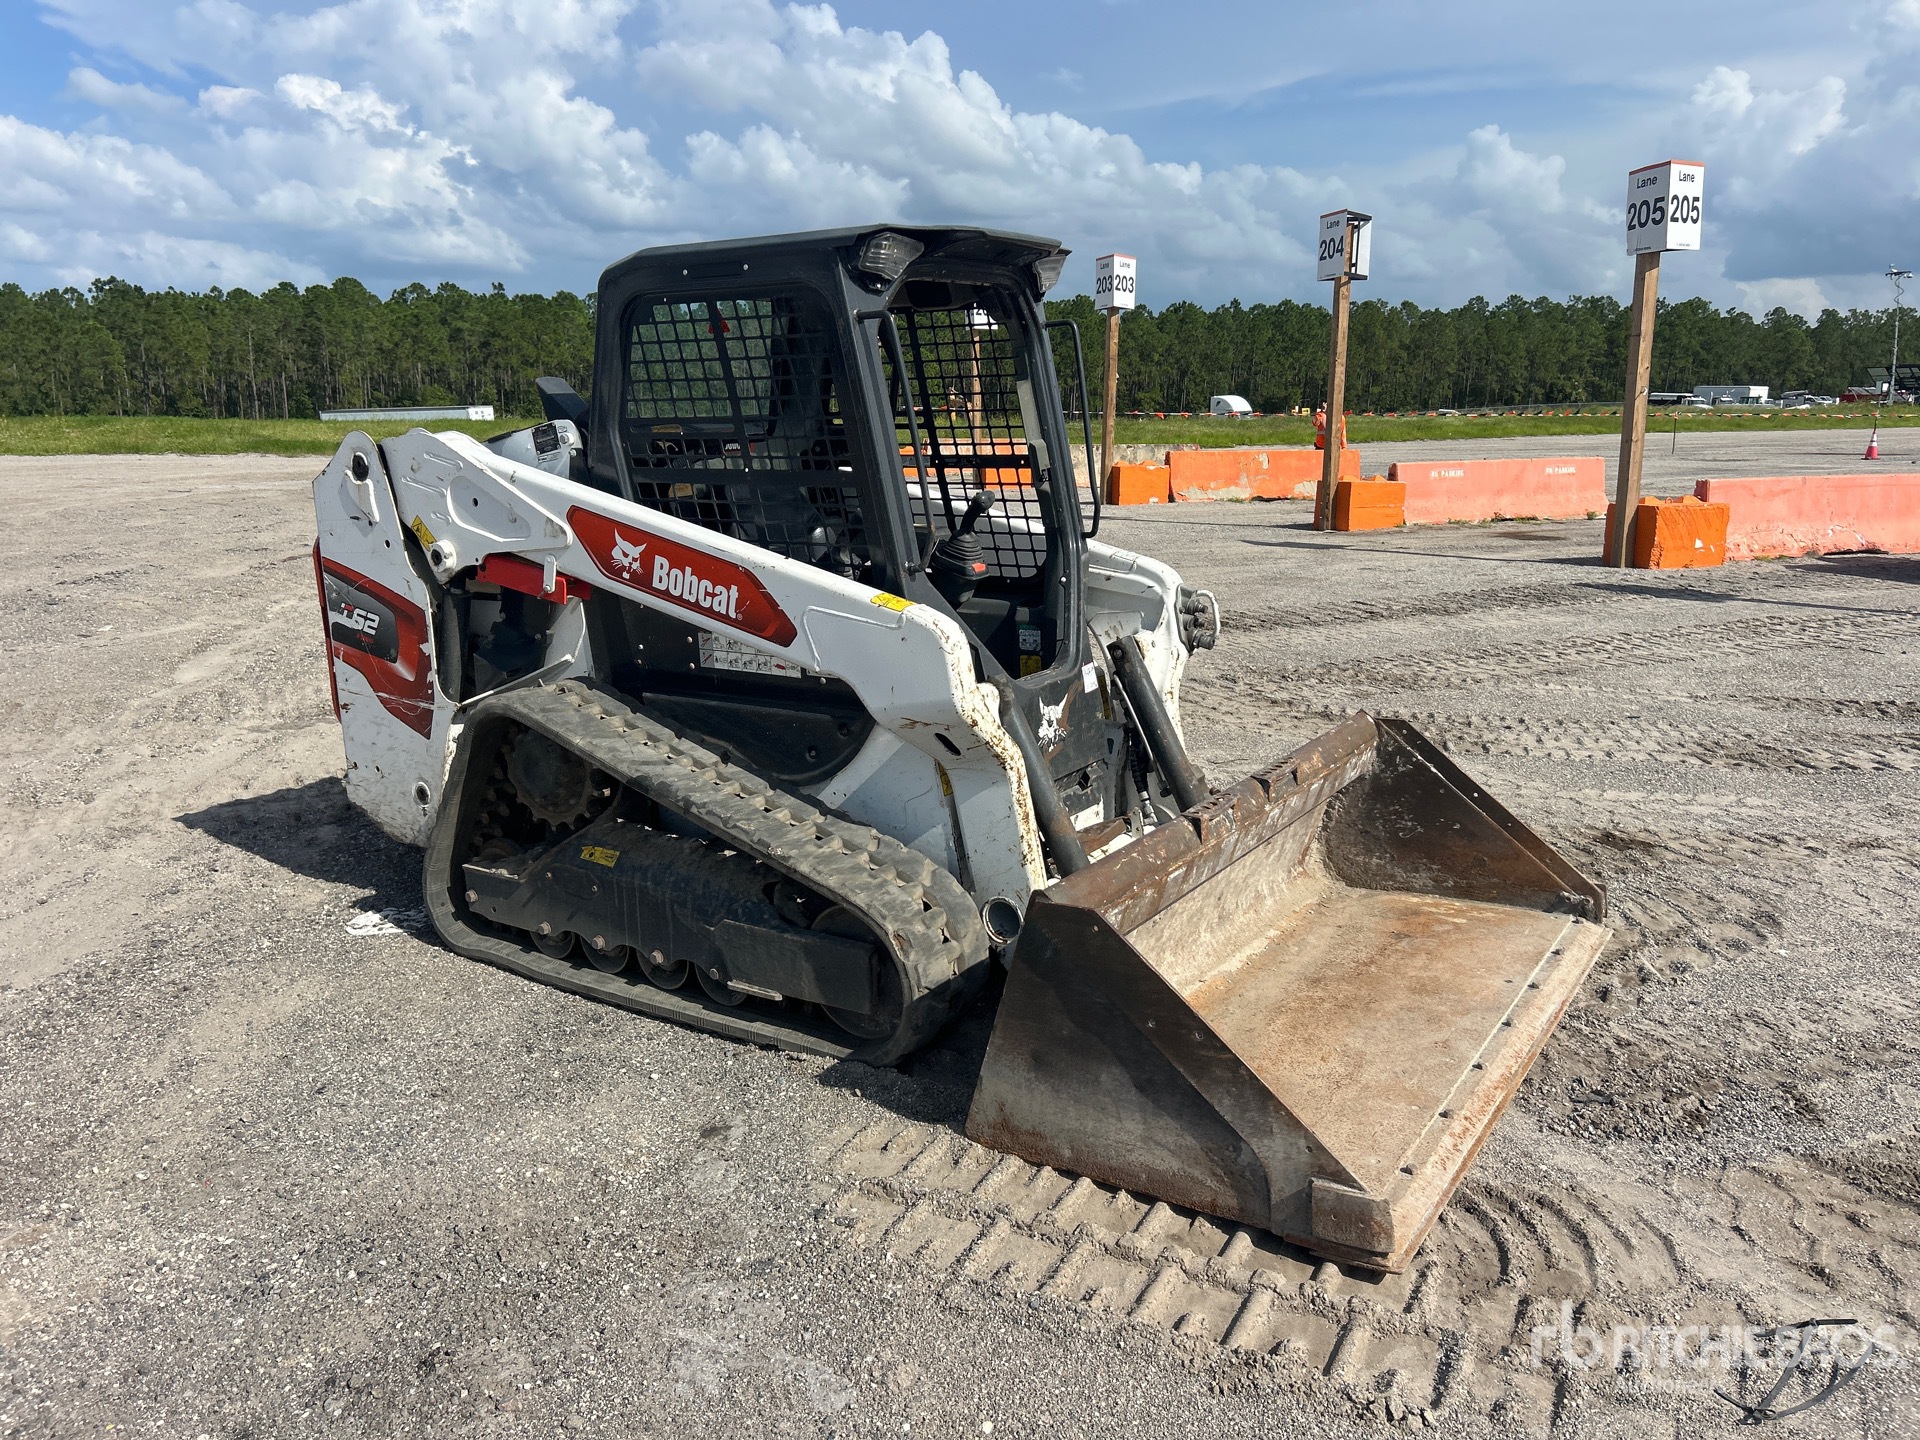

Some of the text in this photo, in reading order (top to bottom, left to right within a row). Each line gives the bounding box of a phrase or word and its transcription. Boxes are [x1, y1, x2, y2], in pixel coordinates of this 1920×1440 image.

[1636, 176, 1658, 189] Lane
[1678, 170, 1695, 183] Lane
[1627, 196, 1666, 231] 205
[1670, 194, 1700, 225] 205
[1326, 220, 1340, 229] Lane
[1319, 235, 1344, 261] 204
[1119, 260, 1131, 269] Lane
[1096, 274, 1113, 294] 203
[1114, 274, 1135, 293] 203
[1441, 469, 1464, 477] PARKING
[1554, 466, 1576, 474] PARKING
[652, 554, 739, 619] Bobcat
